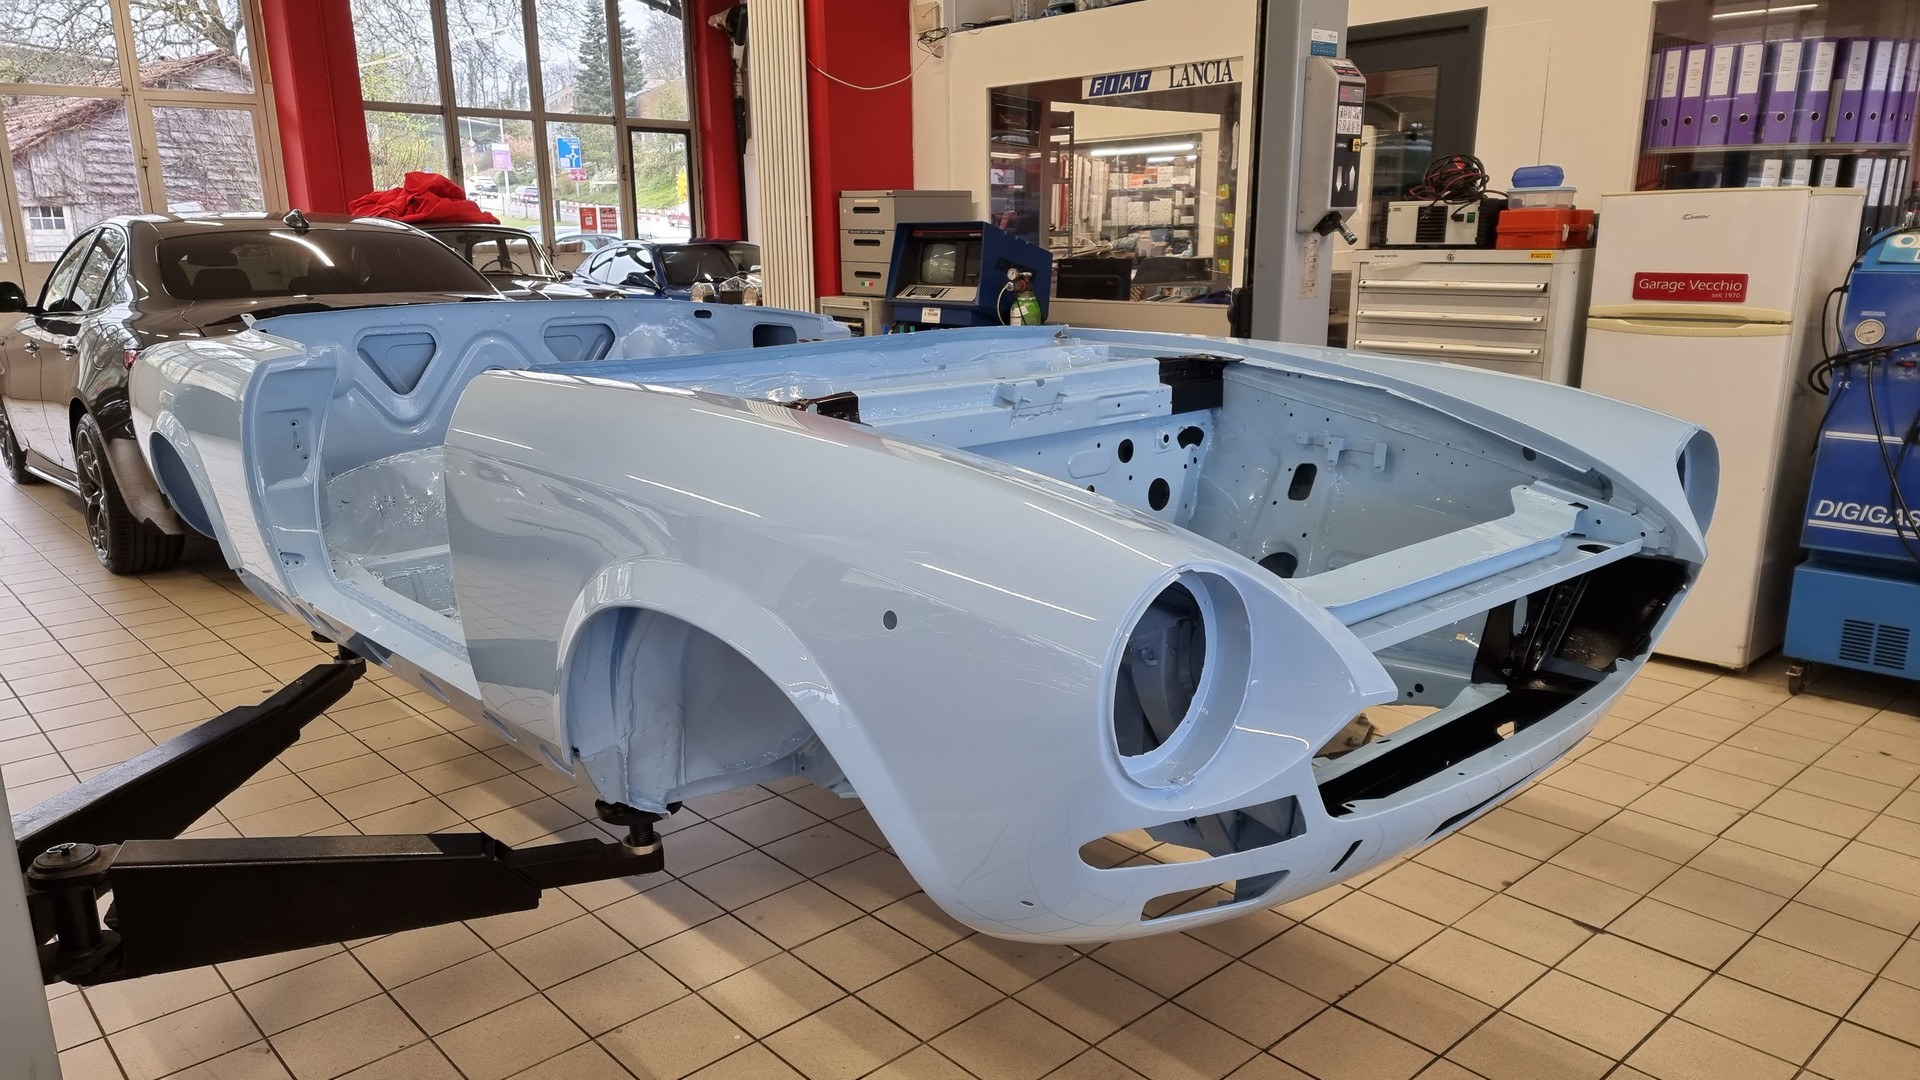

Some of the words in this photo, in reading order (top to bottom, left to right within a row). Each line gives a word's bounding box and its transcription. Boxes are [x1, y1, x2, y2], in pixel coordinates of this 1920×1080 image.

[1093, 74, 1148, 93] FIAT
[1168, 59, 1234, 89] LANCIA
[1639, 278, 1686, 293] Garage
[1689, 279, 1743, 291] Vecchio
